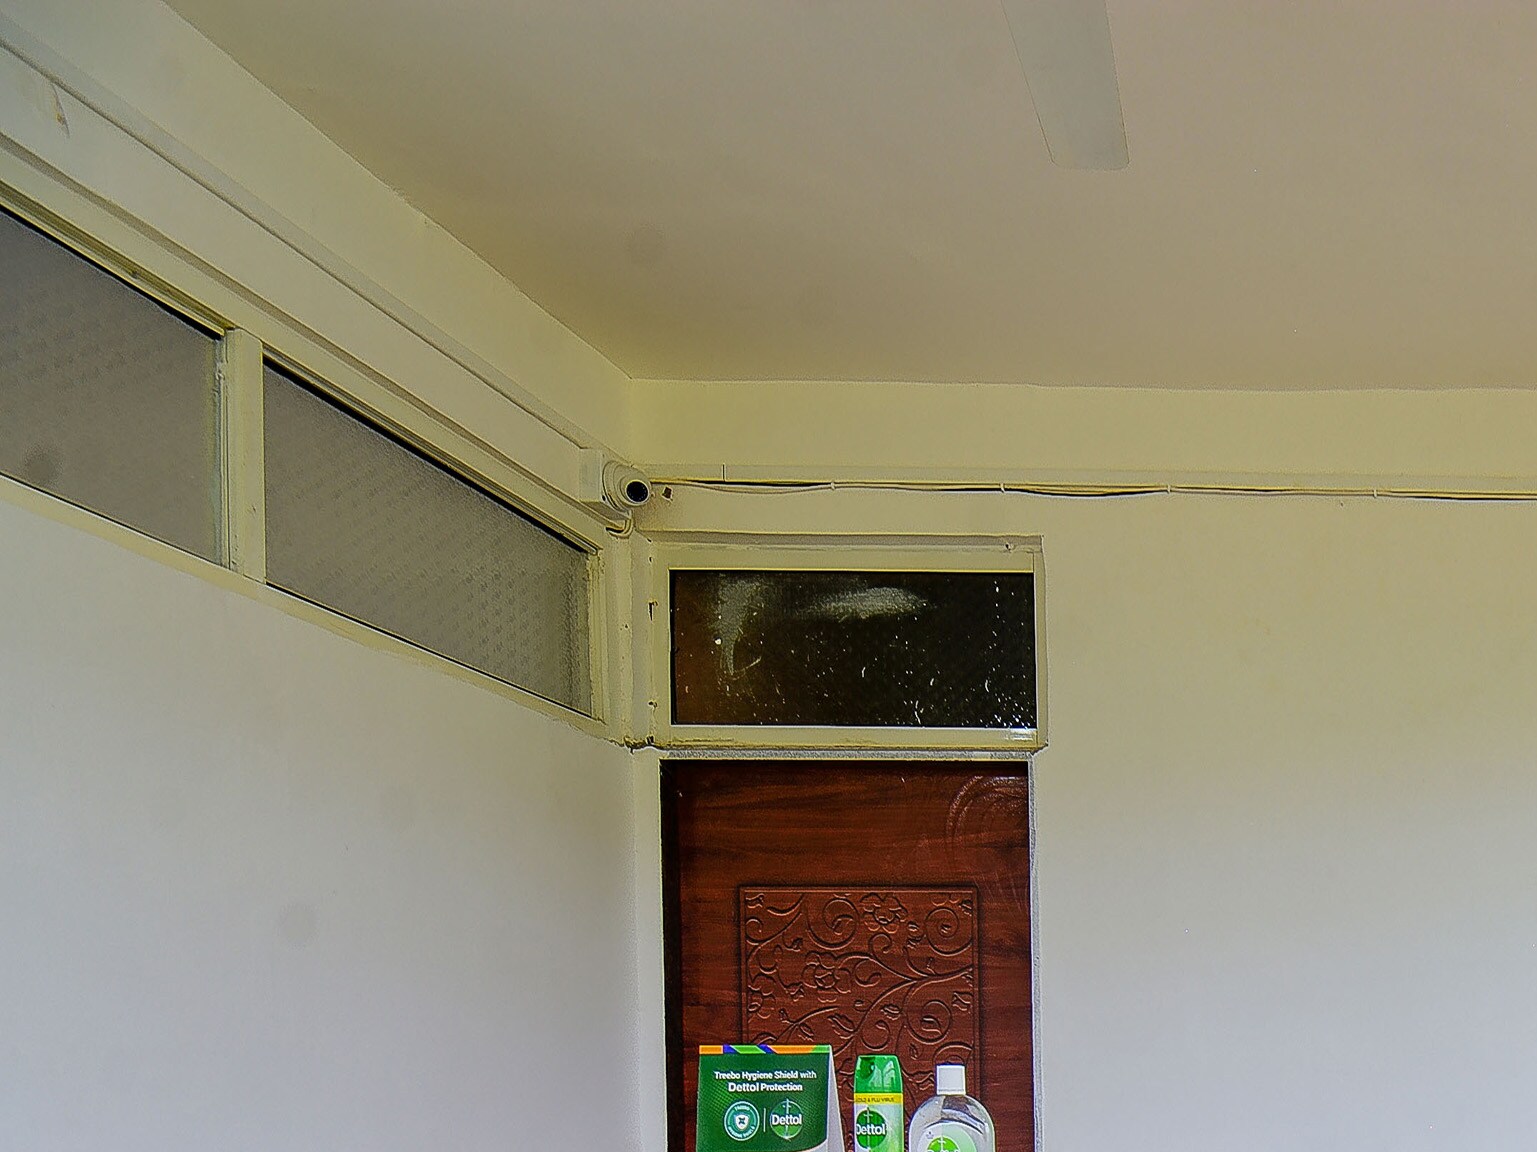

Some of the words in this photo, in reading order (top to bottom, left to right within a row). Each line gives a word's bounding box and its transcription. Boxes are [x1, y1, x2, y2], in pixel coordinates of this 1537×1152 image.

[714, 1071, 741, 1079] Treebo
[741, 1071, 773, 1081] Hygiene
[774, 1071, 799, 1079] Shield
[800, 1071, 817, 1079] with
[728, 1082, 759, 1092] Dettol
[760, 1082, 803, 1091] Protection
[771, 1114, 802, 1125] Dettol
[856, 1123, 886, 1135] Dettol
